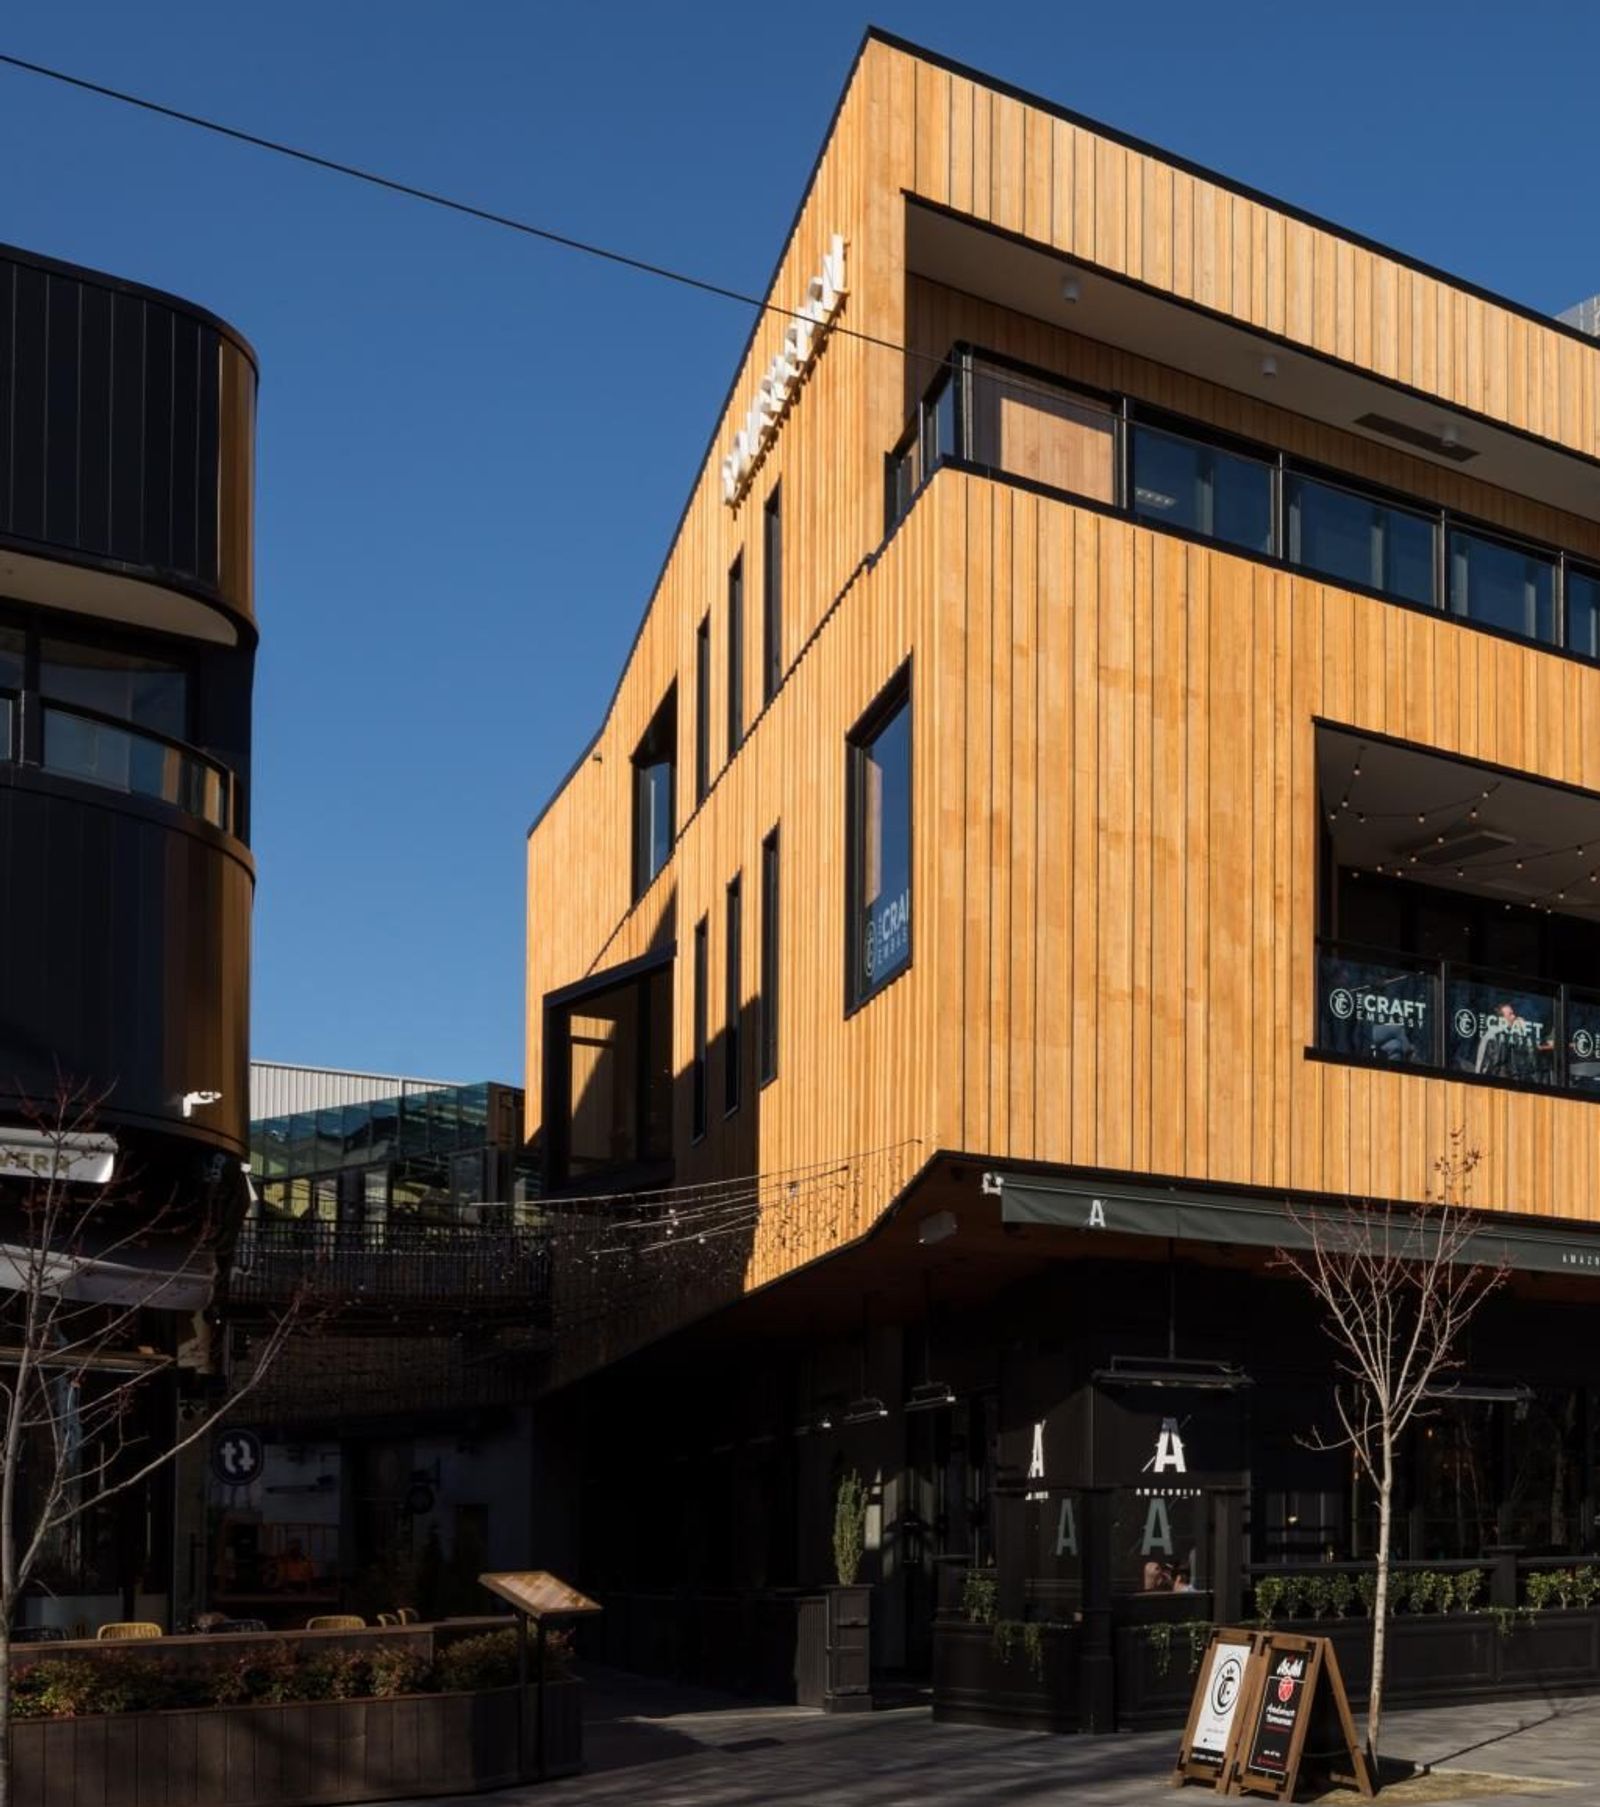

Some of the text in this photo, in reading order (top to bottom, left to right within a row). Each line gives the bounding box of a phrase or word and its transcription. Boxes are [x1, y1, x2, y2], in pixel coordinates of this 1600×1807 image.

[1364, 994, 1427, 1019] CRAFT
[1487, 1014, 1544, 1039] CRAFT
[1089, 1199, 1106, 1228] A
[1029, 1422, 1045, 1479] A
[1151, 1416, 1187, 1473] A
[1056, 1498, 1078, 1556] A
[1140, 1498, 1174, 1556] A
